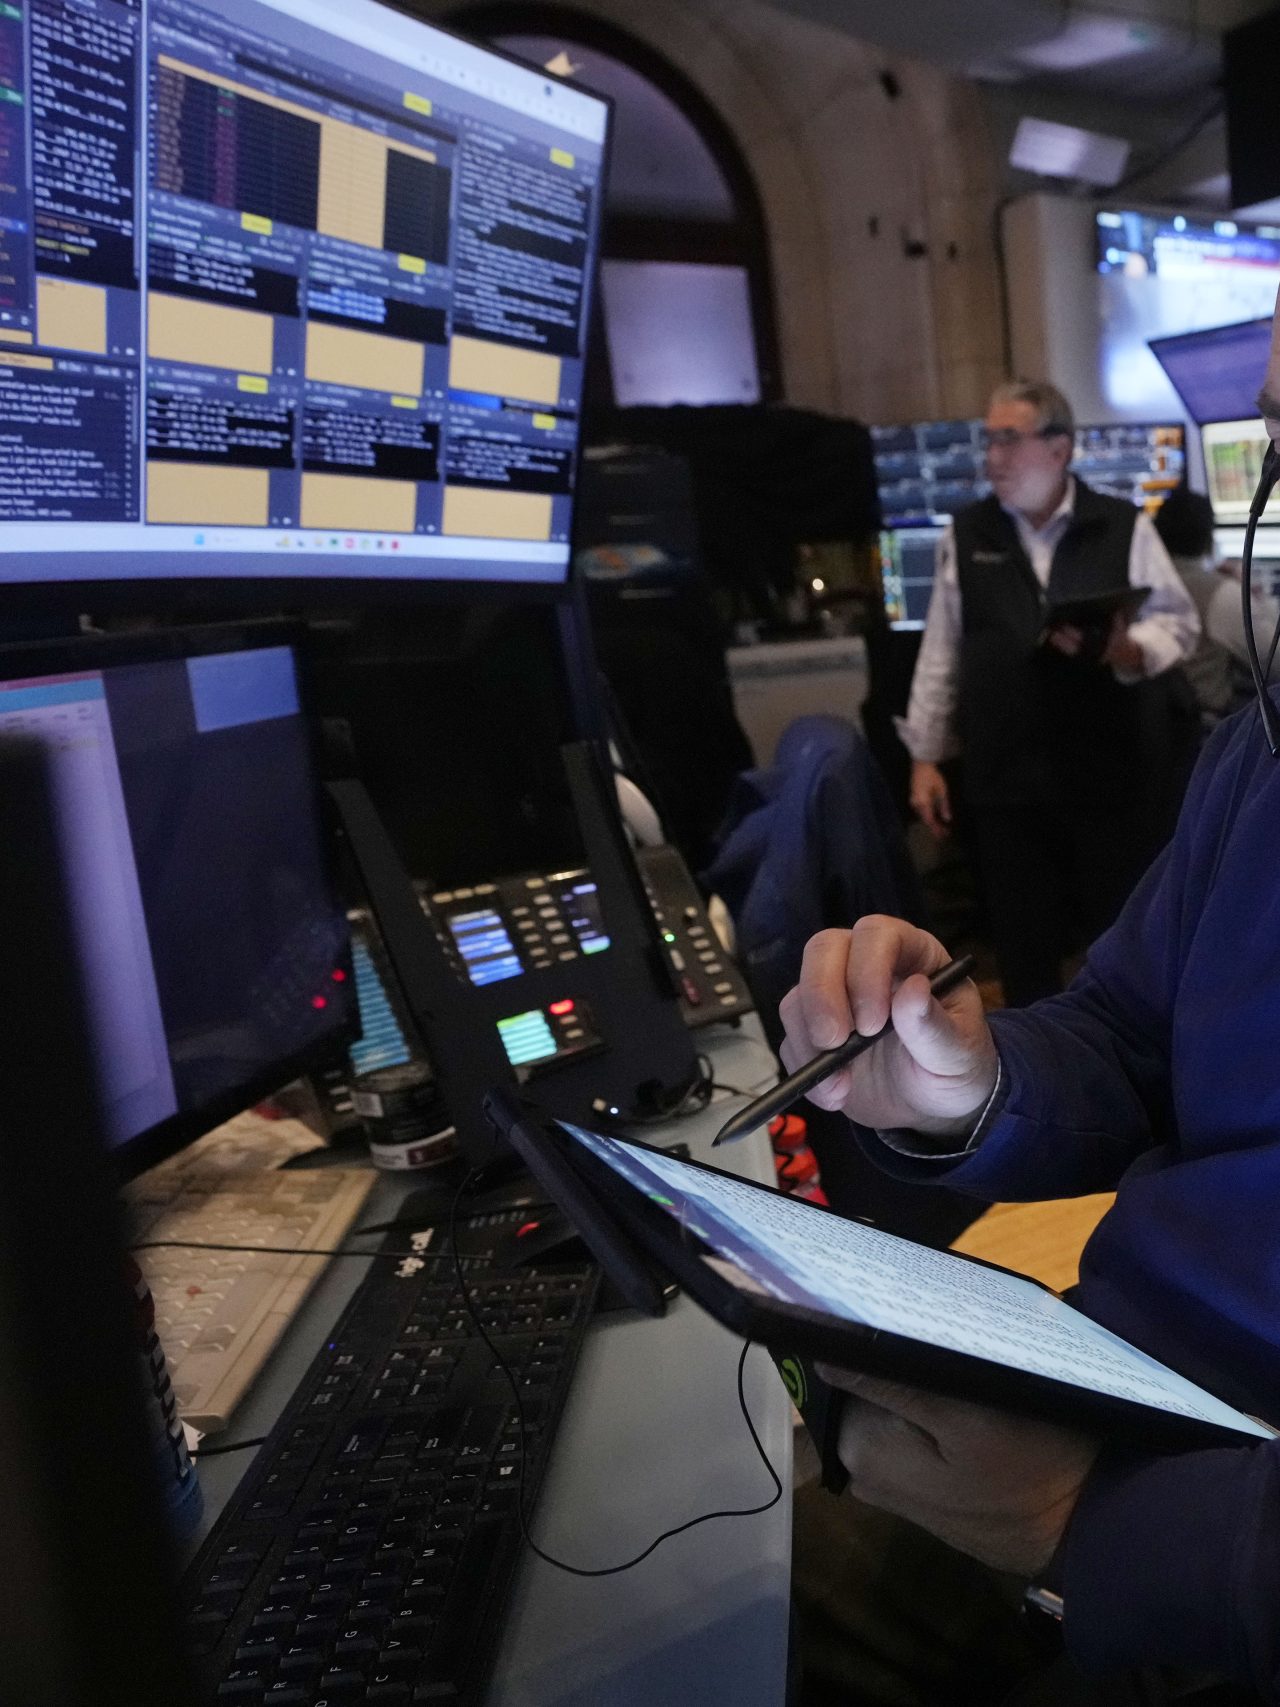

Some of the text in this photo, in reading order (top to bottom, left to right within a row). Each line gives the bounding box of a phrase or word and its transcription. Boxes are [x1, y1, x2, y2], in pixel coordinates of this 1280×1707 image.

[422, 1548, 436, 1557] M
[411, 1578, 424, 1586] N
[357, 1599, 371, 1607] H
[344, 1630, 358, 1638] G
[387, 1641, 401, 1649] V
[375, 1674, 389, 1682] C
[273, 1681, 287, 1689] R
